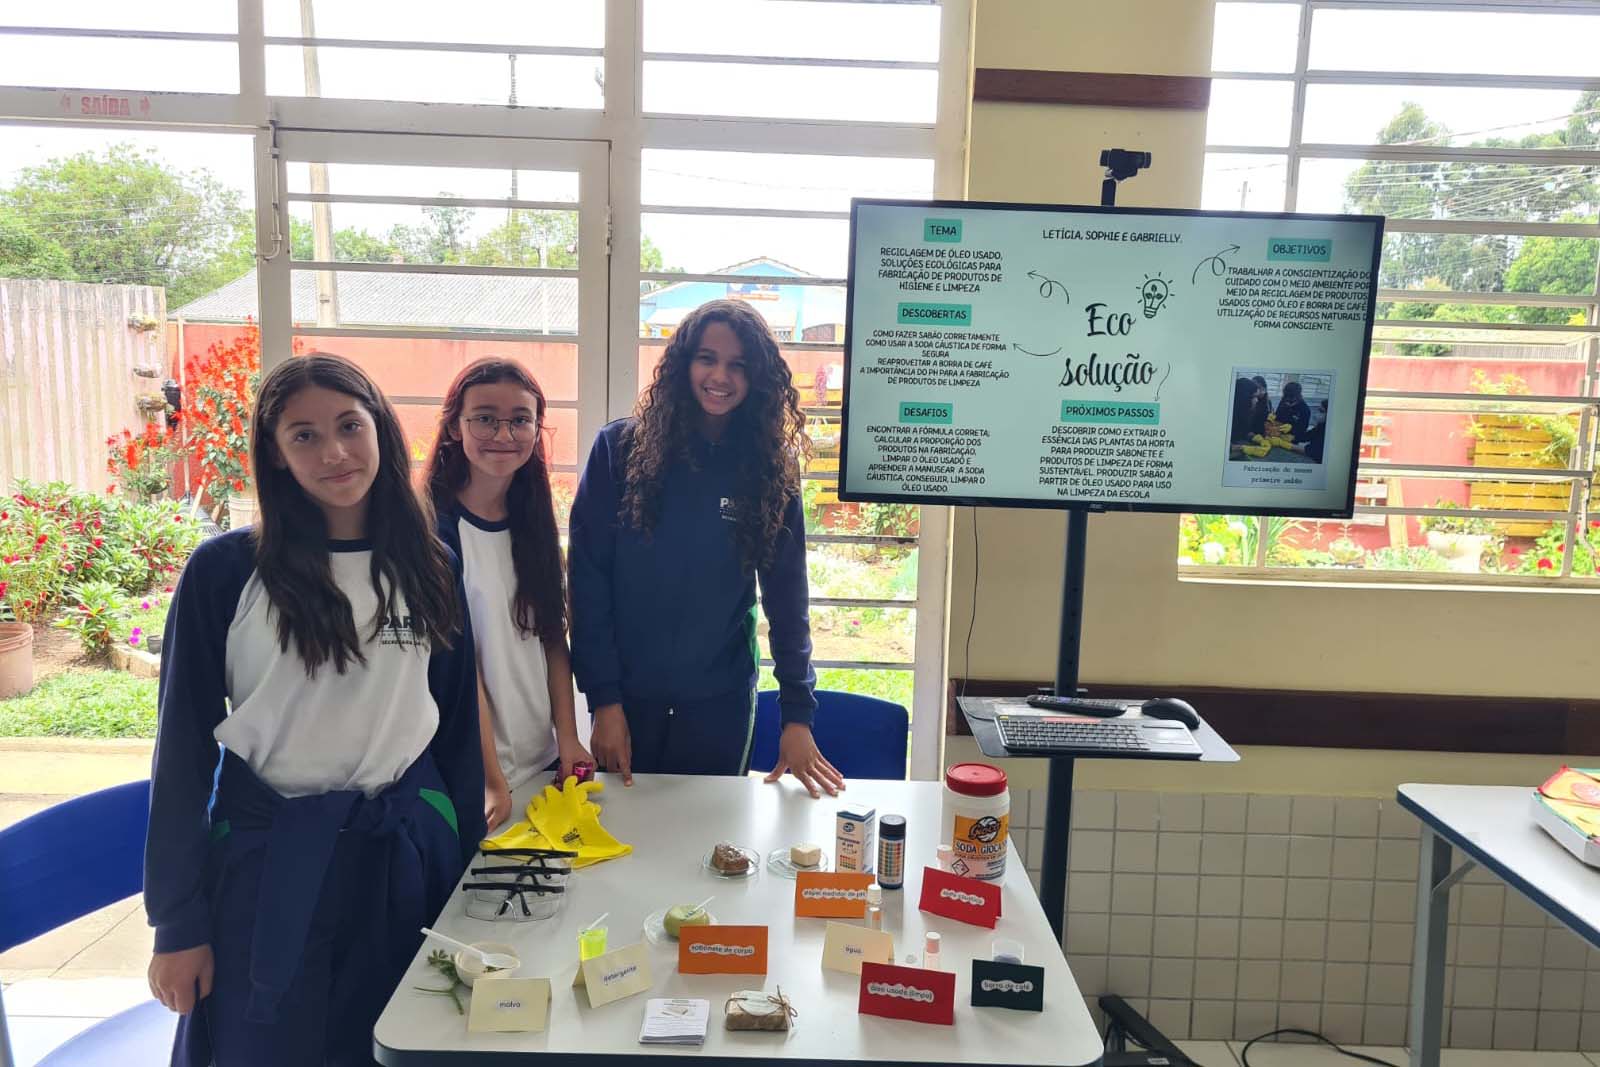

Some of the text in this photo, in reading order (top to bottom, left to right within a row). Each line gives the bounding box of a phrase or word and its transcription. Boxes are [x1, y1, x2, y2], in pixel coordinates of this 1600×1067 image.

[81, 94, 130, 116] SAÍDA
[931, 225, 956, 235] TEMA
[1043, 227, 1083, 240] LETÍCIA,
[1086, 230, 1119, 241] SOPHIE
[881, 247, 933, 258] RECICLAGEM
[936, 249, 946, 258] DE
[948, 248, 970, 258] ÓLEO
[1273, 244, 1326, 255] OBJETIVOS
[881, 257, 1001, 271] SOLUÇÕES ECOLÓGICAS PARA
[879, 268, 1002, 282] FABRICAÇÃO DE PRODUTOS DE
[1229, 266, 1273, 276] TRABALHAR
[1282, 267, 1357, 279] CONSCIENTIZAÇÃO
[900, 281, 980, 292] HIGIENE LIMPEZA
[1225, 277, 1261, 286] CUIDADO
[1312, 281, 1352, 289] AMBIENTE
[1227, 288, 1247, 296] MEIO
[1262, 290, 1311, 298] RECICLAGEM
[1219, 299, 1249, 307] USADOS
[1252, 300, 1275, 308] COMO
[1277, 299, 1297, 309] ÓLEO
[1306, 301, 1332, 309] BORRA
[903, 308, 966, 319] DESCOBERTAS
[1085, 302, 1136, 336] Eco
[1217, 308, 1360, 320] UTILIZAÇÃO DE RECURSOS NATURAIS
[1254, 320, 1280, 328] FORMA
[873, 329, 1000, 341] COMO FAZER SABÃO CORRETAMENTE
[914, 340, 933, 348] SODA
[935, 339, 970, 349] CÁUSTICA
[982, 342, 1006, 350] FORMA
[878, 358, 931, 366] REAPROVEITAR
[939, 359, 962, 367] BORRA
[975, 360, 992, 368] CAFÉ
[866, 366, 915, 375] IMPORTÂNCIA
[966, 370, 1009, 380] FABRICAÇÃO
[1059, 353, 1157, 392] solução
[888, 376, 897, 384] DE
[899, 377, 936, 385] PRODUTOS
[950, 378, 980, 386] LIMPEZA
[904, 407, 947, 417] DESAFIOS
[1067, 404, 1154, 417] PRÓXIMOS PASSOS
[867, 425, 910, 433] ENCONTRAR
[919, 426, 953, 435] FÓRMULA
[1052, 425, 1157, 436] DESCOBRIR COMO EXTRAIR
[874, 435, 981, 446] CALCULAR PROPORÇÃO DOS
[1042, 434, 1080, 444] ESSÊNCIA
[1099, 437, 1134, 446] PLANTAS
[1137, 438, 1146, 446] DA
[1149, 439, 1174, 447] HORTA
[878, 445, 916, 453] PRODUTOS
[1051, 446, 1156, 457] PARA PRODUZIR SABONETE
[883, 454, 964, 464] LIMPAR ÓLEO USADO
[1040, 456, 1173, 468] PRODUTOS DE LIMPEZA DE FORMA
[915, 465, 954, 473] MANUSEAR
[965, 466, 984, 474] SODA
[1097, 468, 1137, 477] PRODUZIR
[1140, 469, 1165, 478] SABÃO
[951, 475, 978, 483] LIMPAR
[1040, 477, 1068, 485] PARTIR
[1082, 477, 1102, 486] ÓLEO
[1105, 479, 1131, 487] USADO
[1133, 480, 1153, 488] PARA
[902, 482, 947, 492] ÓLEO USADO
[1057, 487, 1150, 498] NA LIMPEZA DA ESCOLA
[956, 841, 976, 854] SODA
[691, 945, 722, 953] sabonete
[499, 1000, 520, 1008] malva
